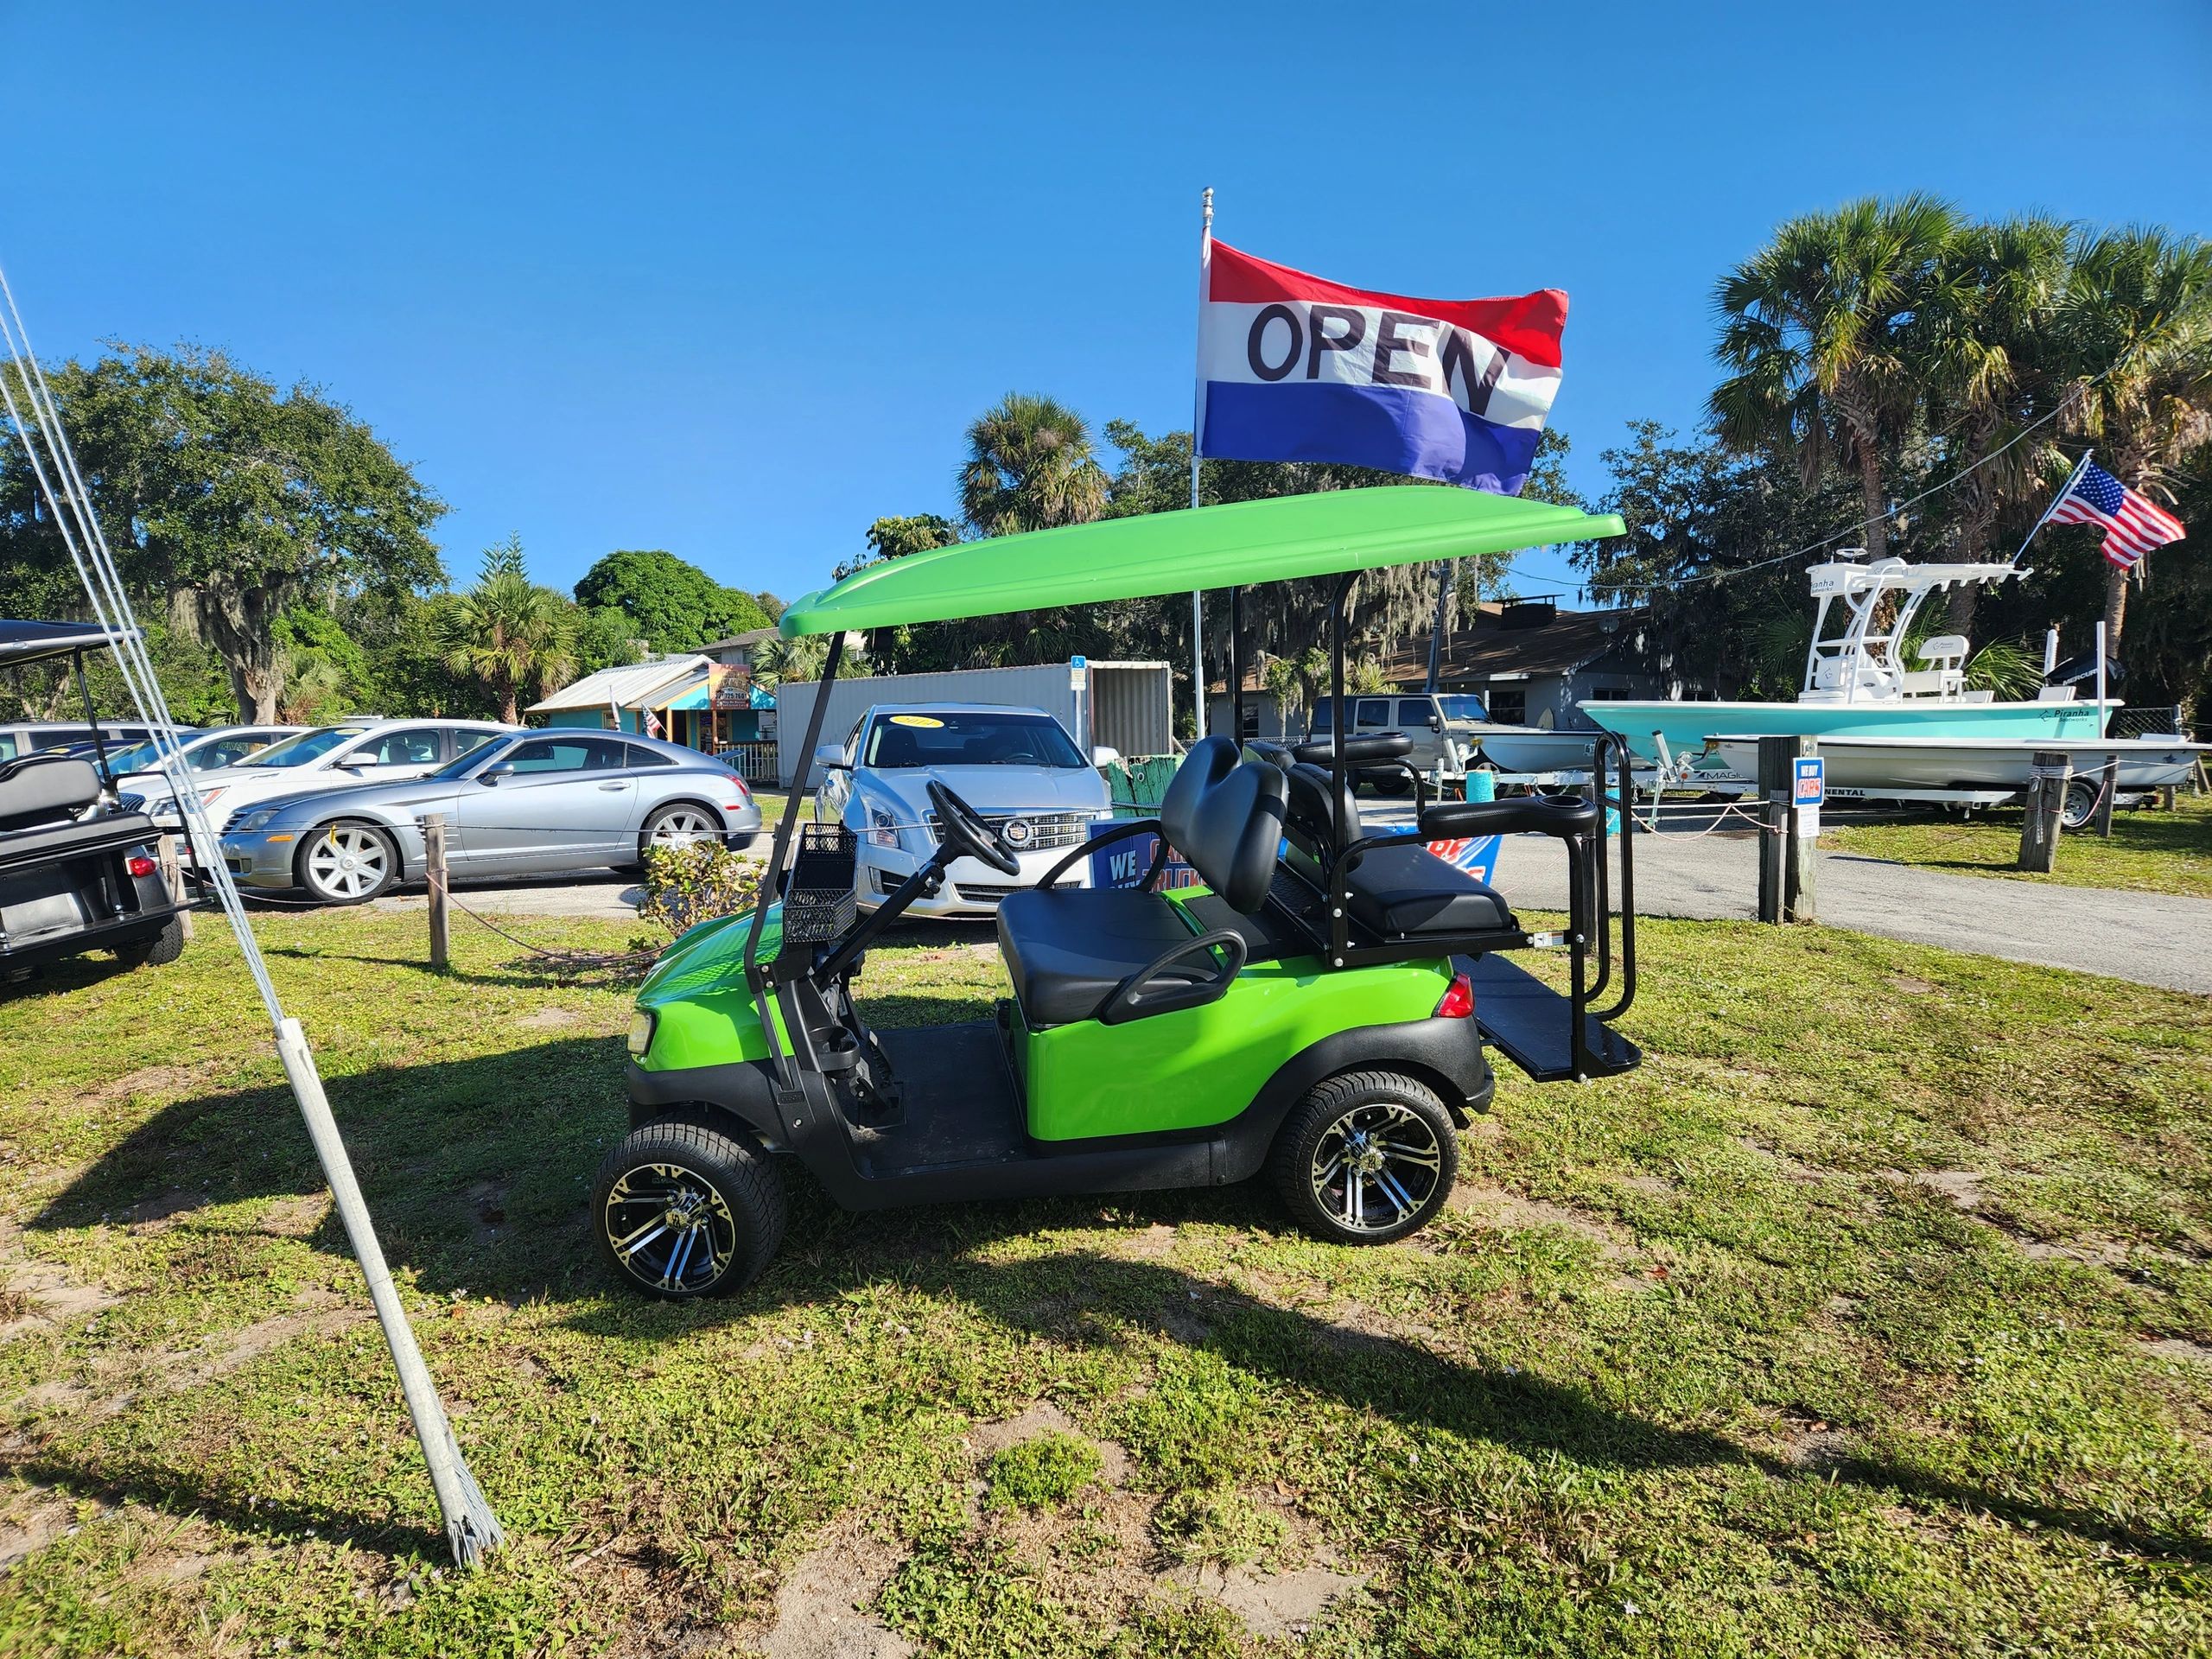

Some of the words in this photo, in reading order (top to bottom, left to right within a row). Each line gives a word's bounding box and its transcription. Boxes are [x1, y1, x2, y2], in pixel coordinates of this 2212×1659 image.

[1248, 303, 1511, 416] OPEN
[2063, 668, 2098, 686] MERCUR
[1797, 778, 1821, 798] CARS
[1109, 850, 1136, 880] WE
